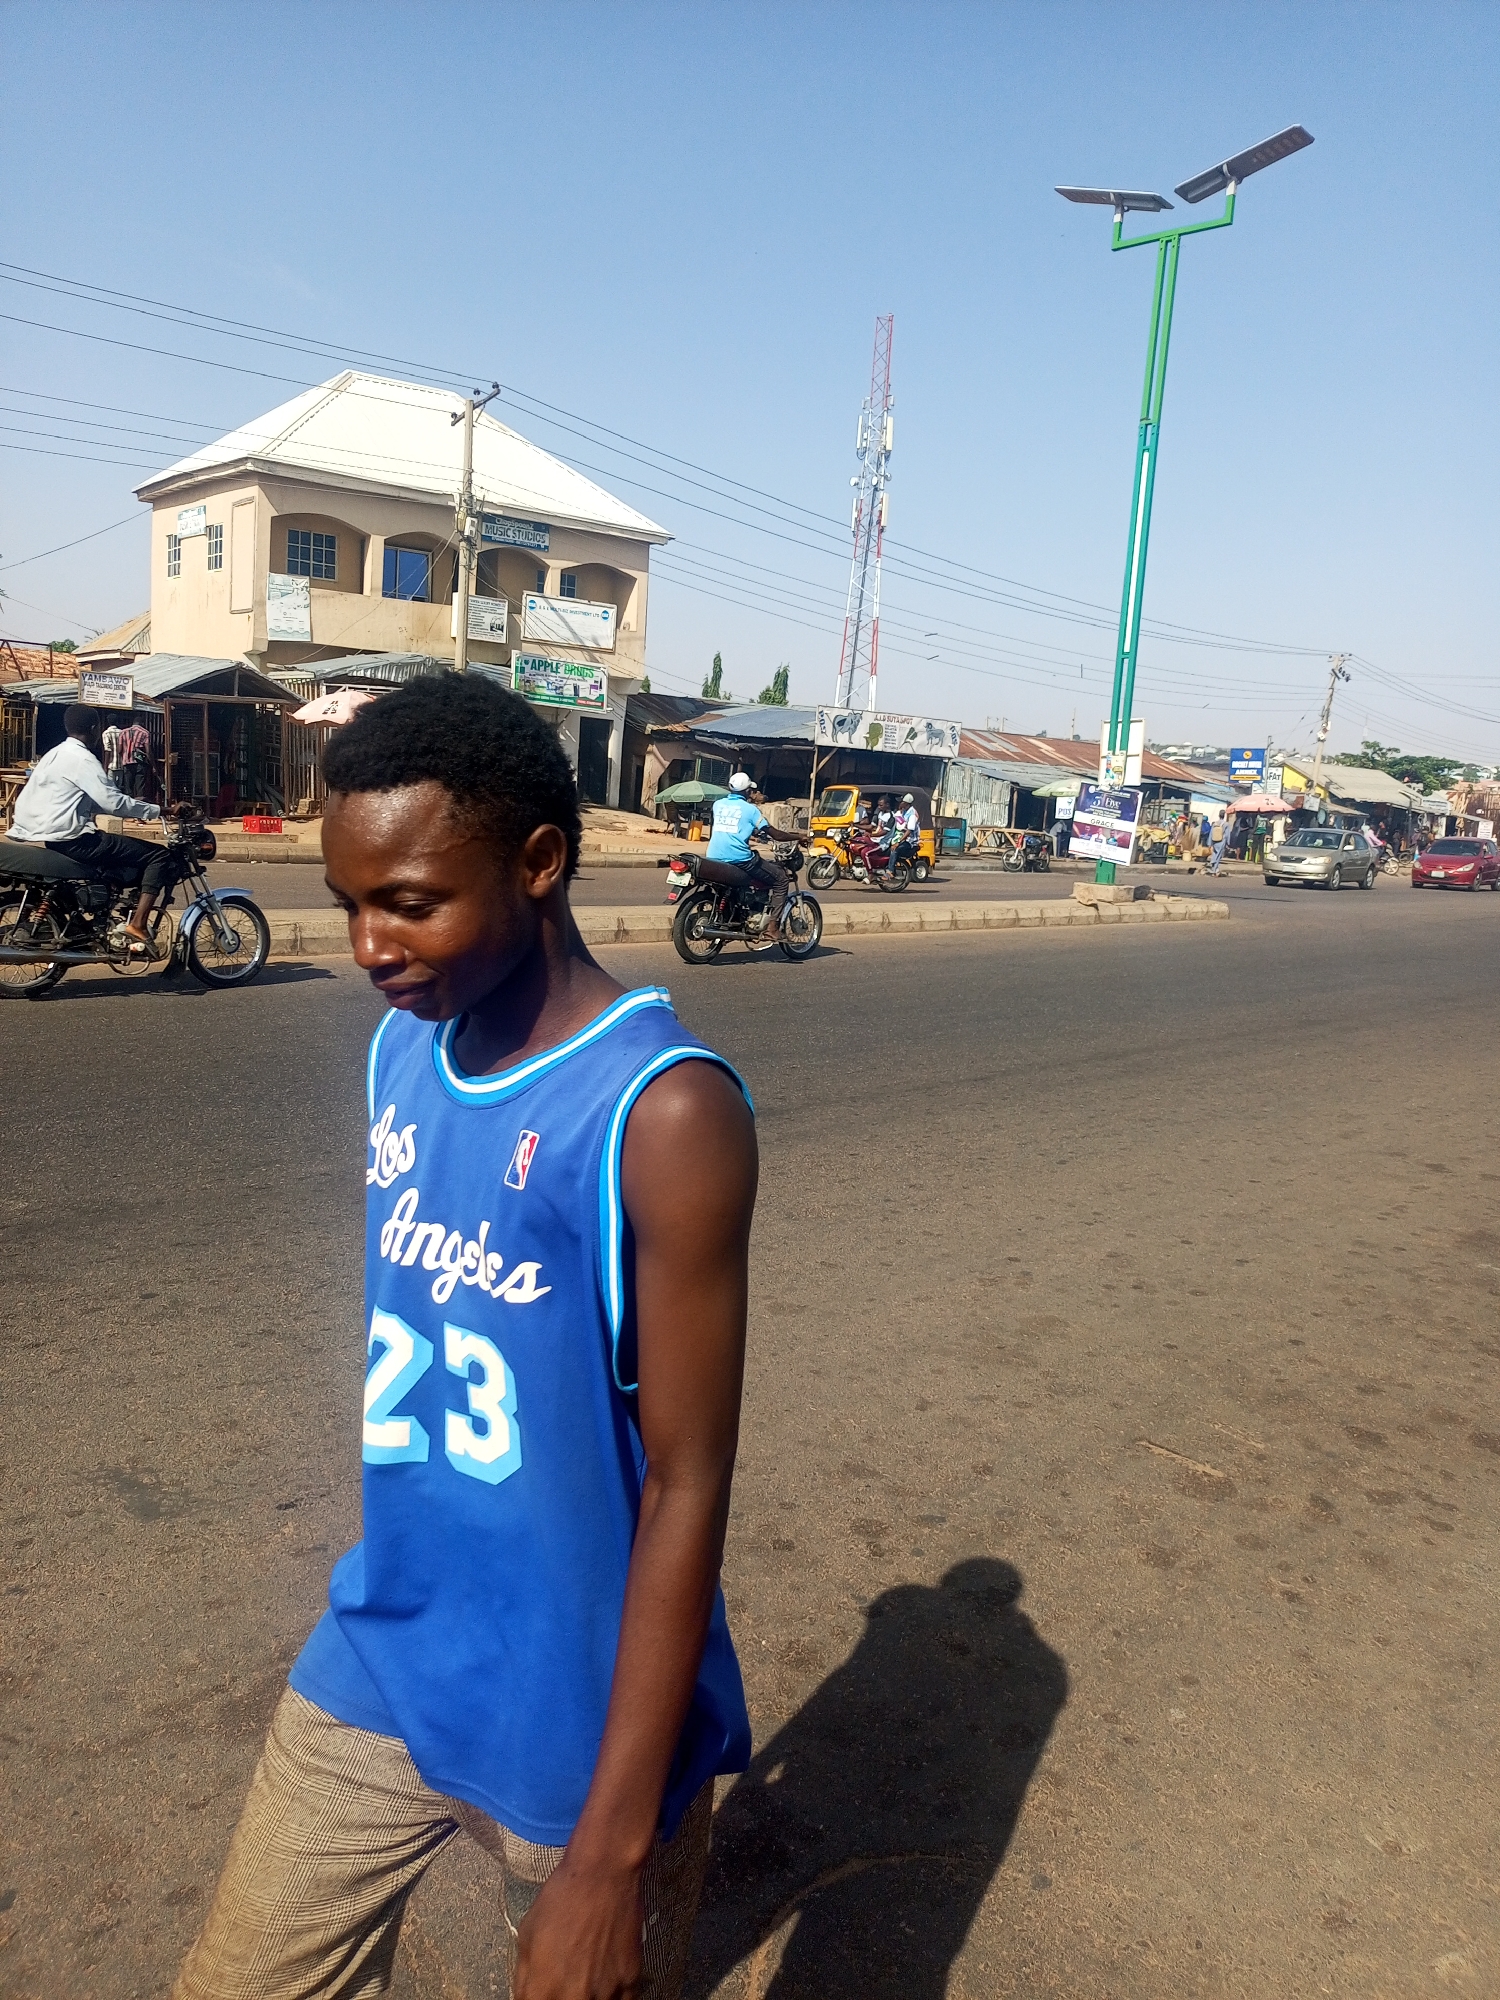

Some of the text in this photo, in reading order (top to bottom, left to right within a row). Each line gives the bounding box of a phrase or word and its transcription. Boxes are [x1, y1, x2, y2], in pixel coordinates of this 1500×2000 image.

[485, 523, 511, 538] MUSIC
[511, 528, 546, 544] STUDIOS
[81, 672, 130, 685] YAMBAWO
[530, 659, 560, 674] APPLE
[564, 663, 594, 678] DRUGS
[1058, 807, 1071, 816] POS
[1090, 818, 1115, 829] GRACE
[366, 1104, 417, 1188] Los
[380, 1188, 552, 1304] Angeles
[362, 1305, 522, 1486] 23
